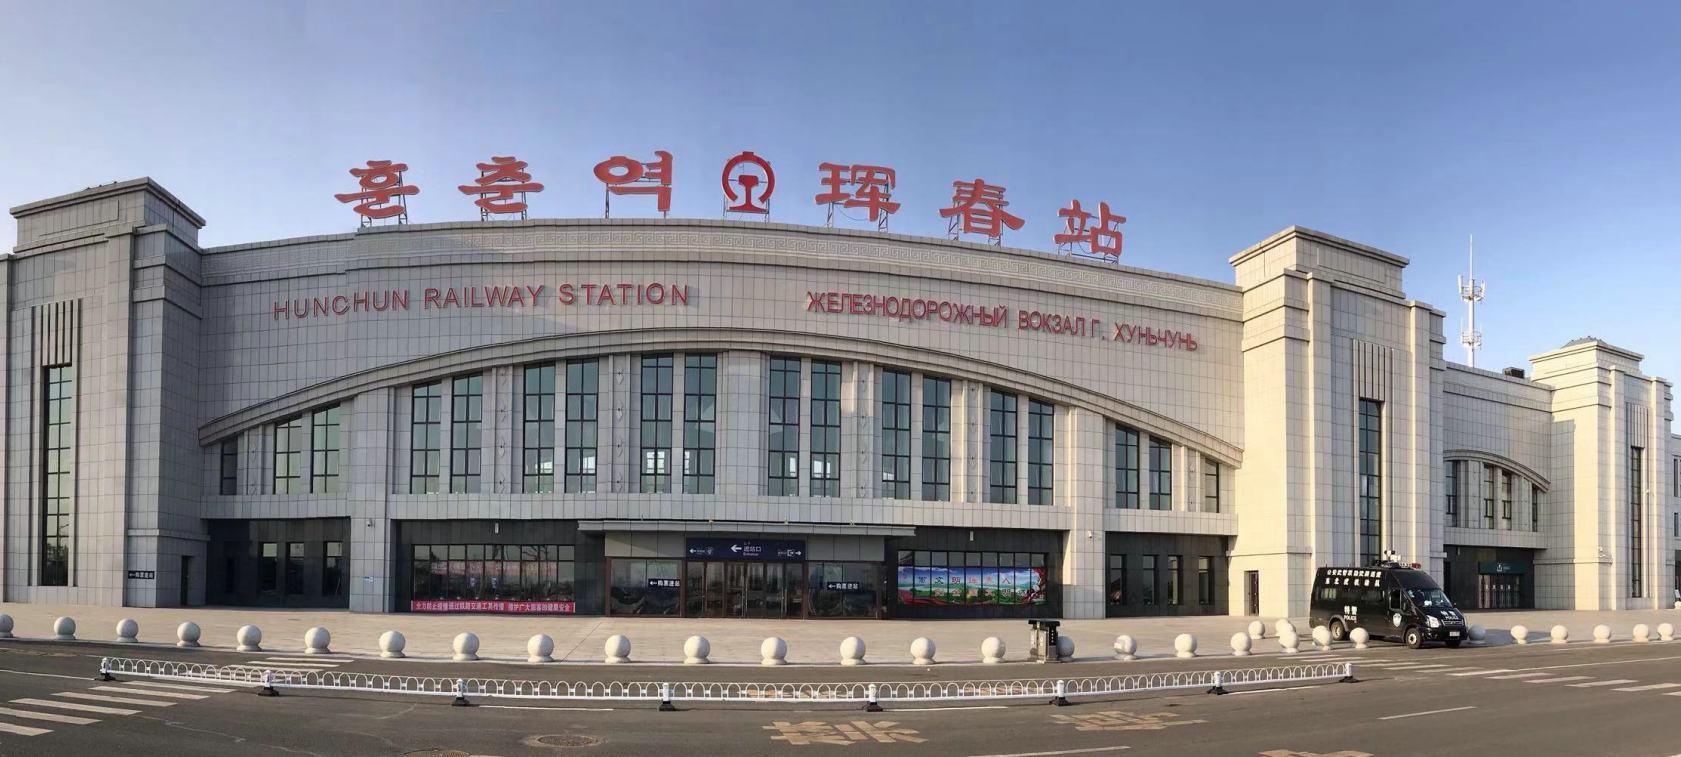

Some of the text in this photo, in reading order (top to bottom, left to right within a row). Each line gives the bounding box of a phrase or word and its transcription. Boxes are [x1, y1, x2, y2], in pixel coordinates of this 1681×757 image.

[334, 150, 674, 219] 훈춘역
[814, 162, 1127, 256] 珲春站
[273, 282, 689, 320] HUNCHUN RAILWAY STATION
[806, 291, 1199, 353] ЖЕЛЕЗНОДОРОЖНЫЙ ВОКЗАЛ Г. ХУНЬЧУНЬ
[657, 579, 680, 587] 购票进站
